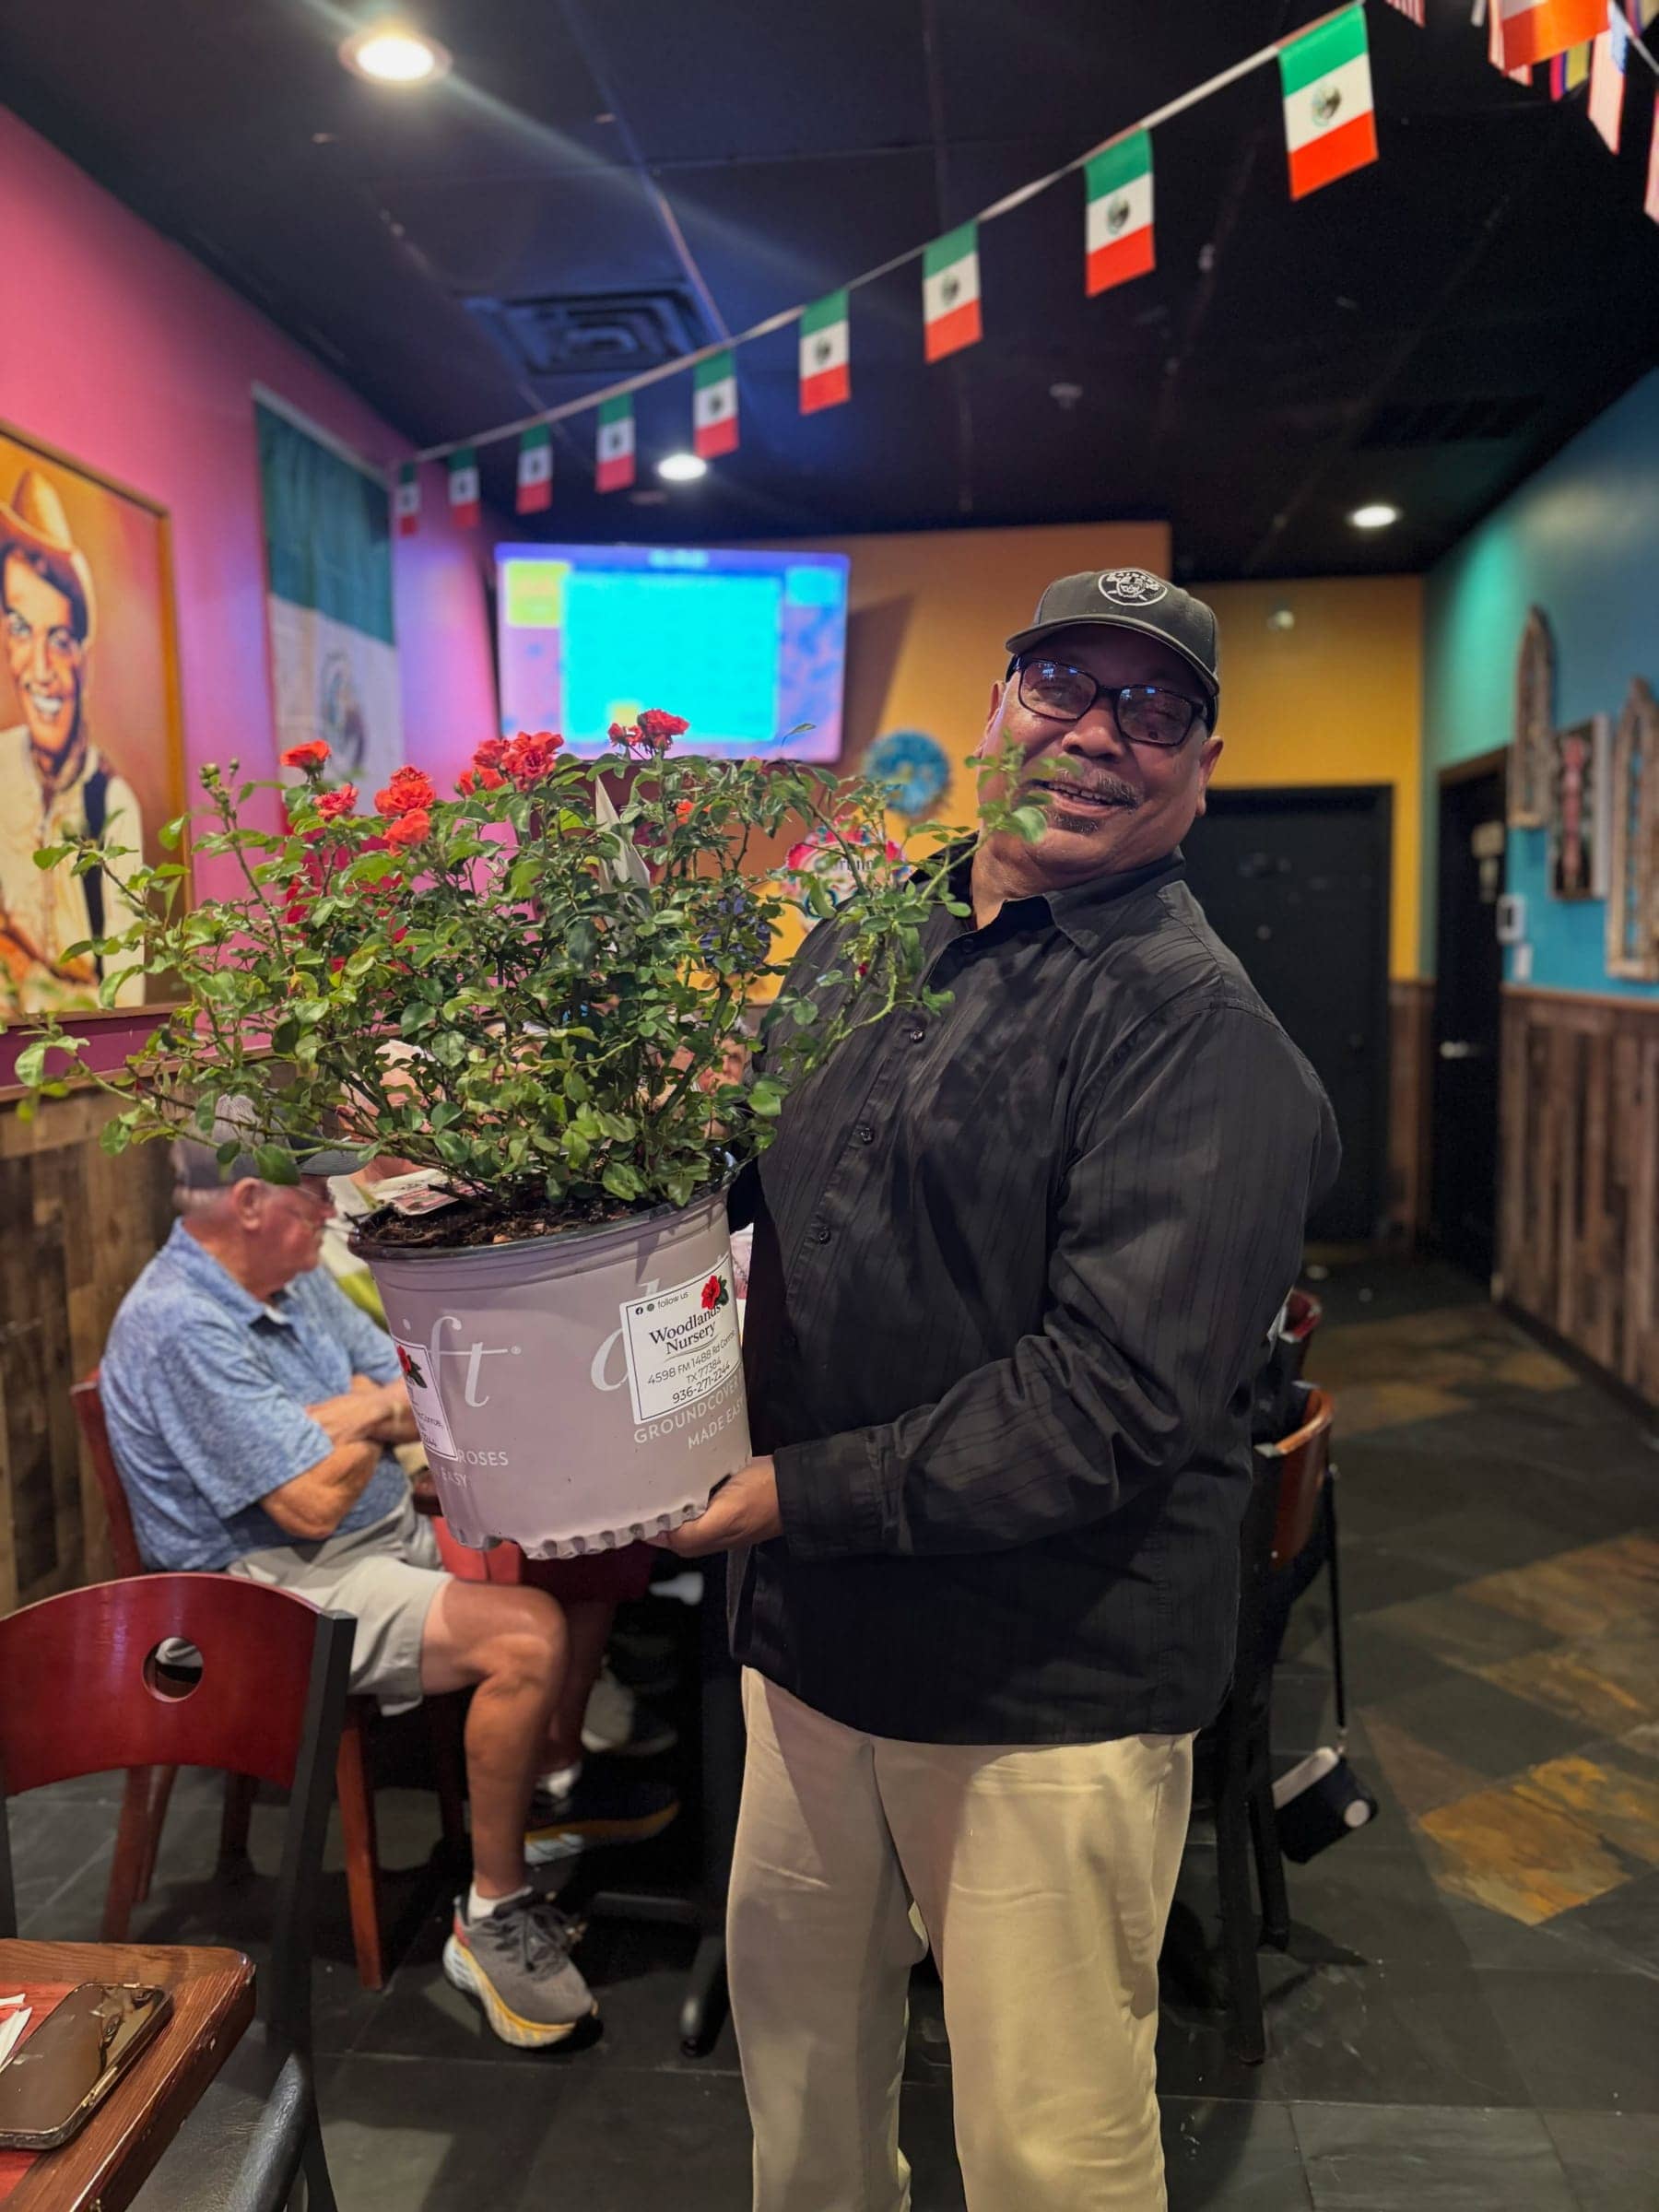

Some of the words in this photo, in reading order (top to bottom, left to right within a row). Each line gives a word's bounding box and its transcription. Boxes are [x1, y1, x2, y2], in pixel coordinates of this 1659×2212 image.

[657, 1296, 679, 1309] follow
[680, 1291, 689, 1300] us
[649, 1304, 722, 1345] Woodlands
[665, 1321, 716, 1355] Nursery
[647, 1366, 677, 1384] 4598
[677, 1361, 690, 1374] FM
[691, 1348, 712, 1368] 1488
[712, 1344, 721, 1355] Rd
[672, 1359, 731, 1404] 936-271-2244
[686, 1372, 698, 1385] TX
[698, 1356, 722, 1379] 77384
[688, 1414, 724, 1451] MADE
[456, 1448, 510, 1466] ROSES
